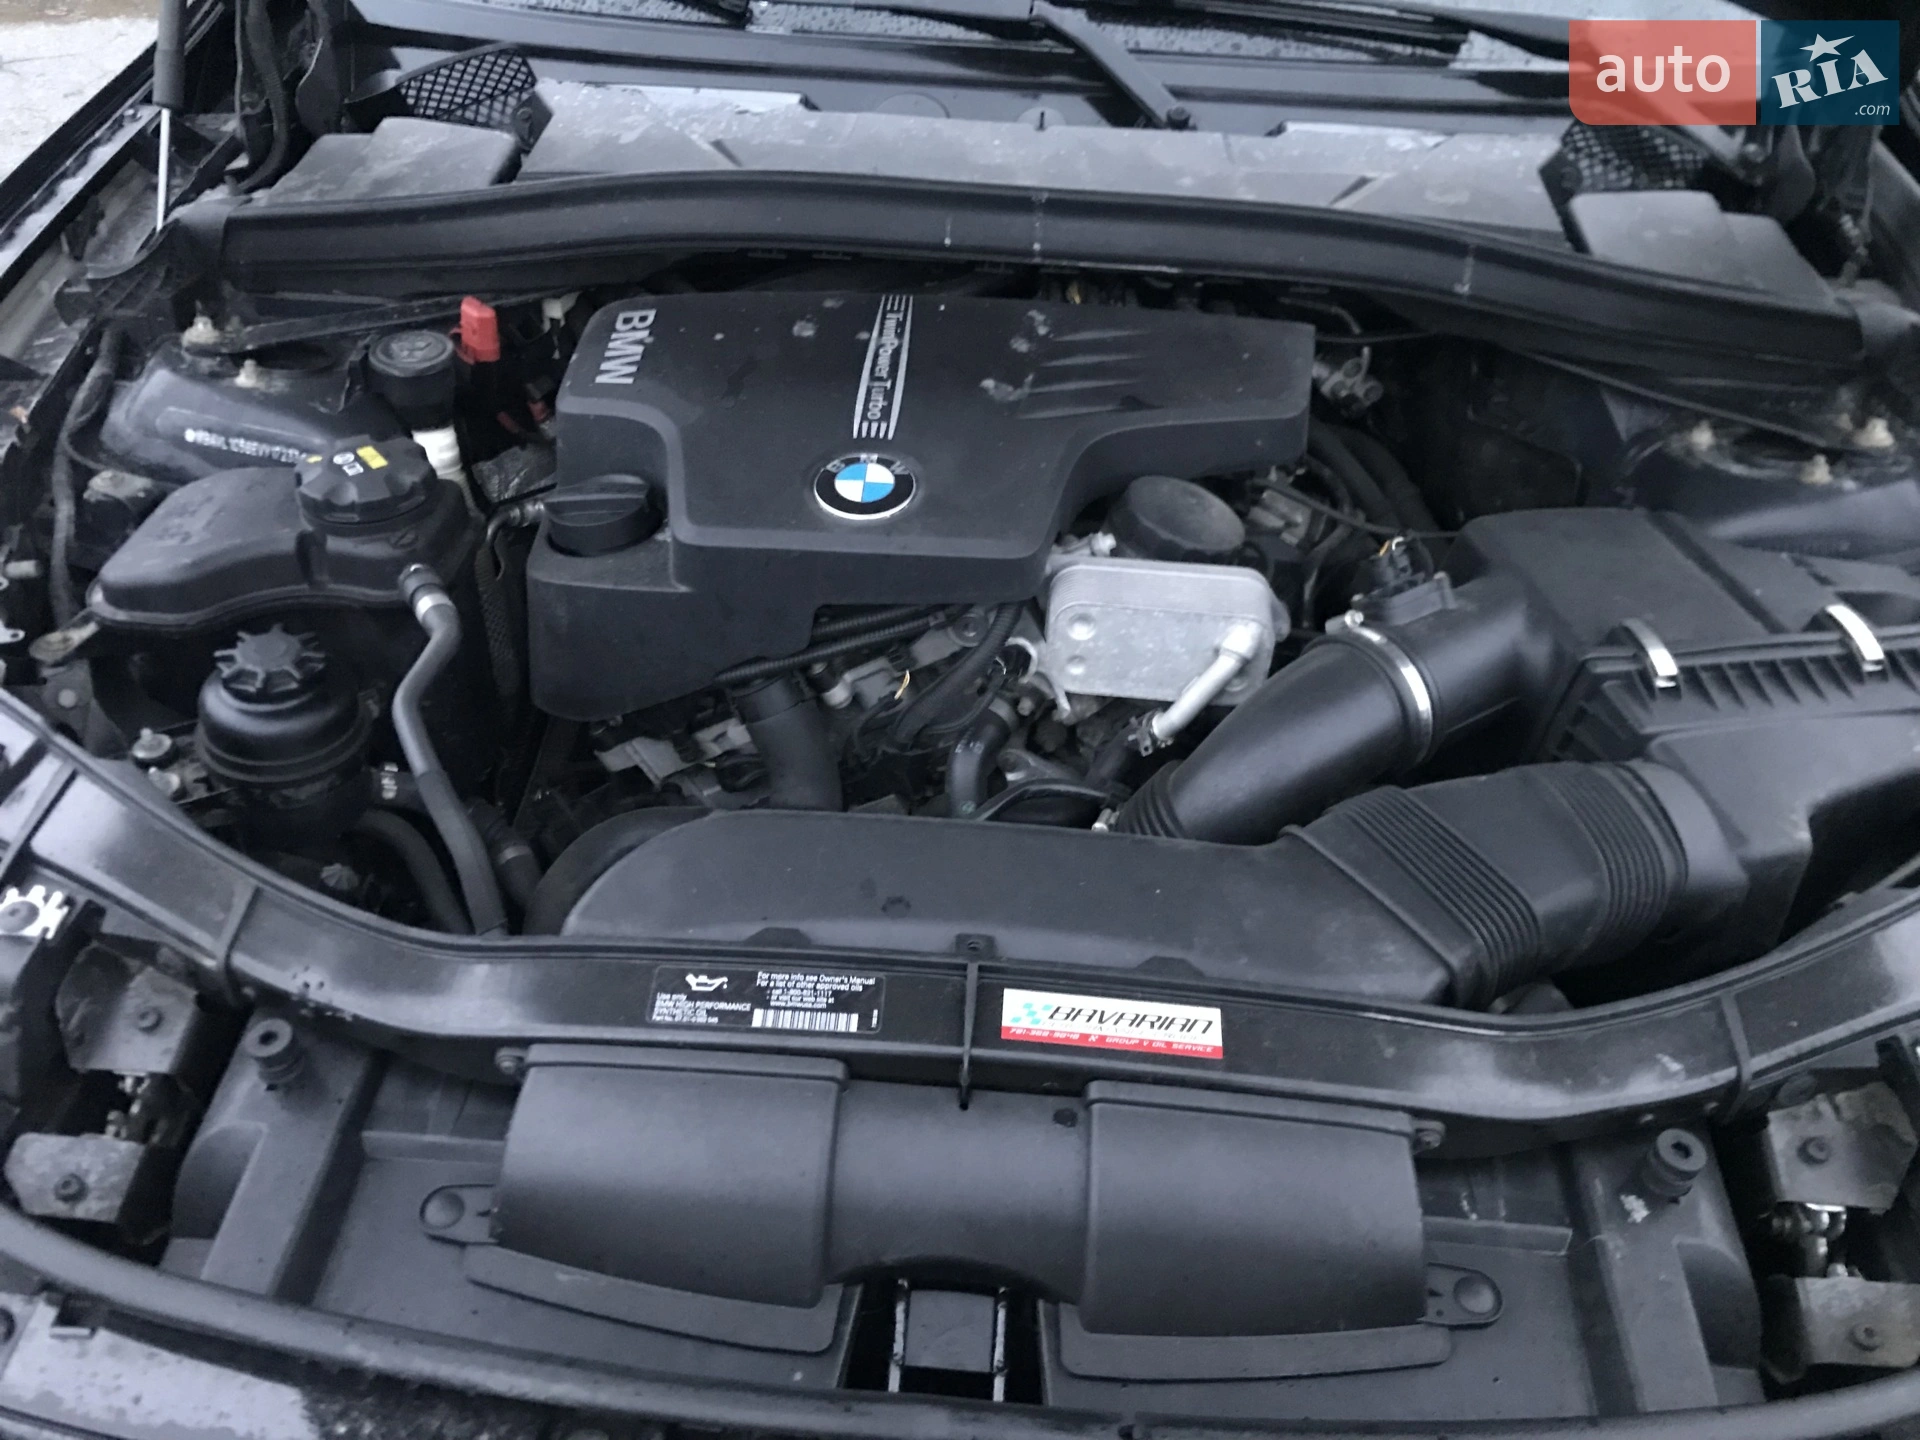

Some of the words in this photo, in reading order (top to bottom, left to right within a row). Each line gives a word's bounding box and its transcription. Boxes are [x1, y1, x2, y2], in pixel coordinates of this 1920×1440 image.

[594, 307, 657, 384] BMW
[875, 312, 903, 379] TwinPower
[867, 380, 892, 420] Turbo
[757, 979, 769, 987] For
[796, 982, 815, 990] other
[816, 983, 850, 992] approved
[851, 984, 863, 992] oils
[758, 971, 770, 980] For
[771, 973, 789, 981] more
[790, 973, 805, 982] info
[819, 975, 848, 984] Owner's
[849, 976, 876, 985] Manual
[695, 1001, 752, 1011] PERFORMANCE
[1048, 1006, 1213, 1035] BAVARIAN
[1171, 1043, 1215, 1054] SERVICE
